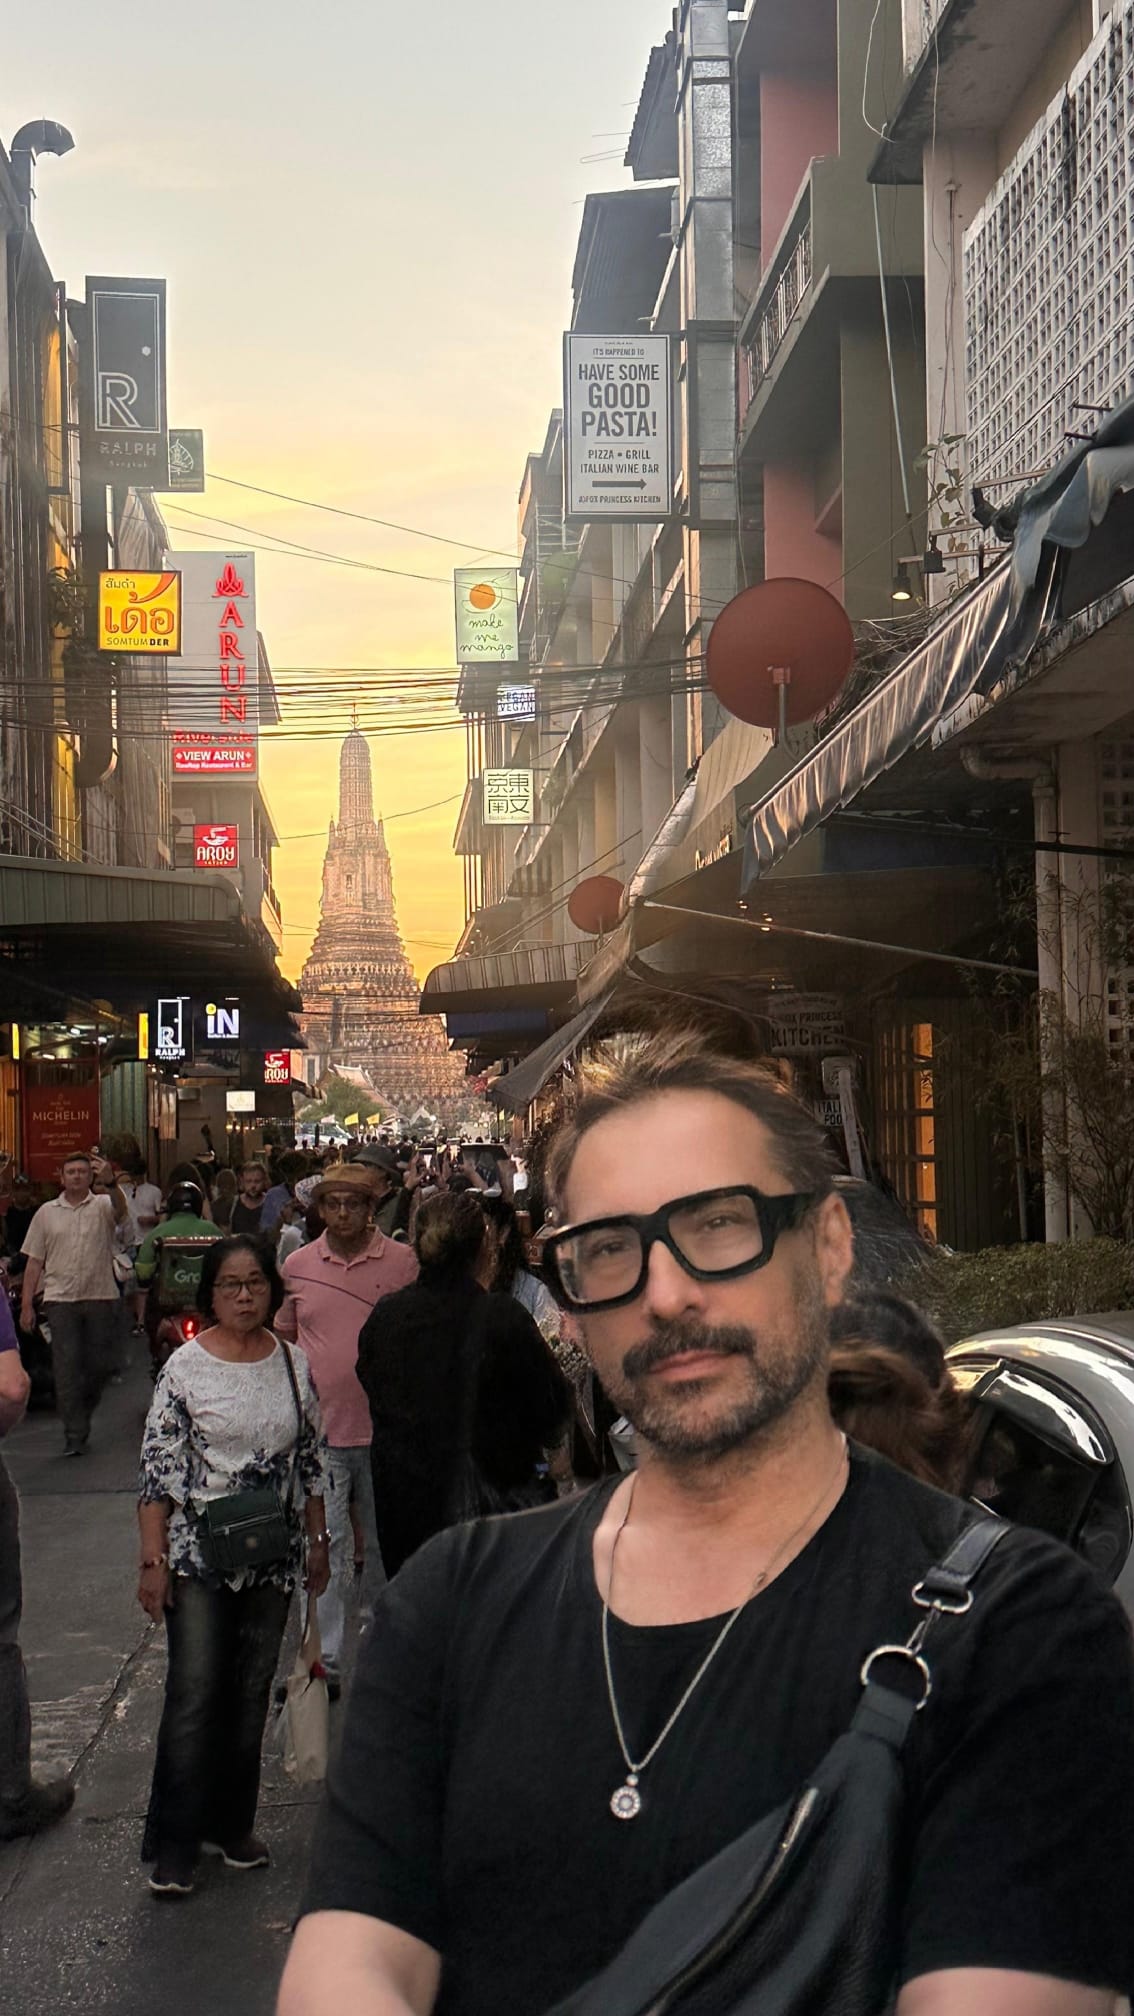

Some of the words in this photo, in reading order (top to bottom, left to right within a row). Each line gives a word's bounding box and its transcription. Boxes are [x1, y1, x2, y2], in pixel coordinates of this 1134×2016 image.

[579, 363, 614, 380] HAVE
[619, 363, 660, 380] SOME
[98, 371, 141, 427] R
[589, 382, 650, 408] GOOD
[581, 411, 657, 437] PASTA!
[100, 441, 157, 456] RALPH
[588, 449, 614, 460] PIZZA
[625, 449, 651, 460] GRILL
[580, 463, 613, 474] ITALIAN
[615, 463, 639, 474] WINE
[642, 463, 660, 474] BAR
[469, 613, 503, 628] make
[475, 634, 499, 642] me
[460, 644, 513, 660] mango
[219, 600, 247, 724] ARUN
[182, 751, 211, 760] VIEW
[213, 751, 244, 760] ARUN
[771, 1024, 845, 1047] KITCHEN
[155, 1048, 186, 1056] RALPH
[264, 1068, 288, 1080] ROY
[33, 1111, 89, 1120] MICHELIN
[825, 1114, 842, 1125] FOO
[174, 1269, 202, 1284] Gra
